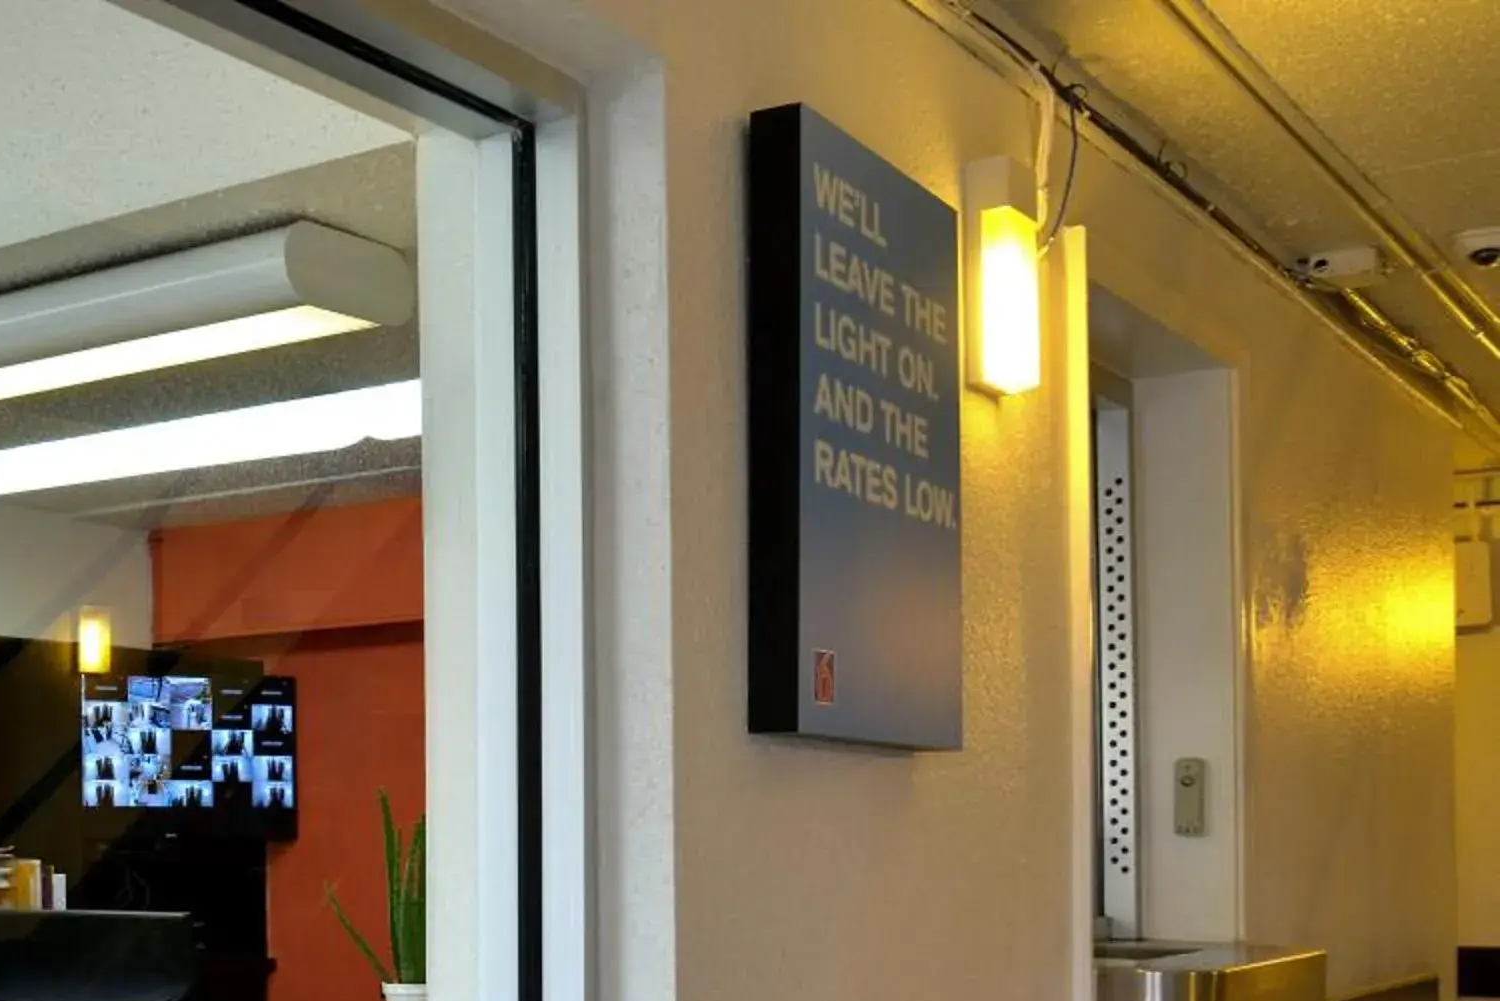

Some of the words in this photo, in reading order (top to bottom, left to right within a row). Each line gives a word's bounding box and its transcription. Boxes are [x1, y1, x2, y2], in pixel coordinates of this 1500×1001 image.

[813, 162, 888, 248] WE'LL
[815, 231, 895, 317] LEAVE
[901, 281, 947, 344] THE
[815, 302, 892, 378] LIGHT
[899, 345, 939, 402] ON.
[814, 373, 873, 433] AND
[881, 400, 929, 458] THE
[814, 440, 898, 510] RATES
[905, 474, 957, 530] LOW.
